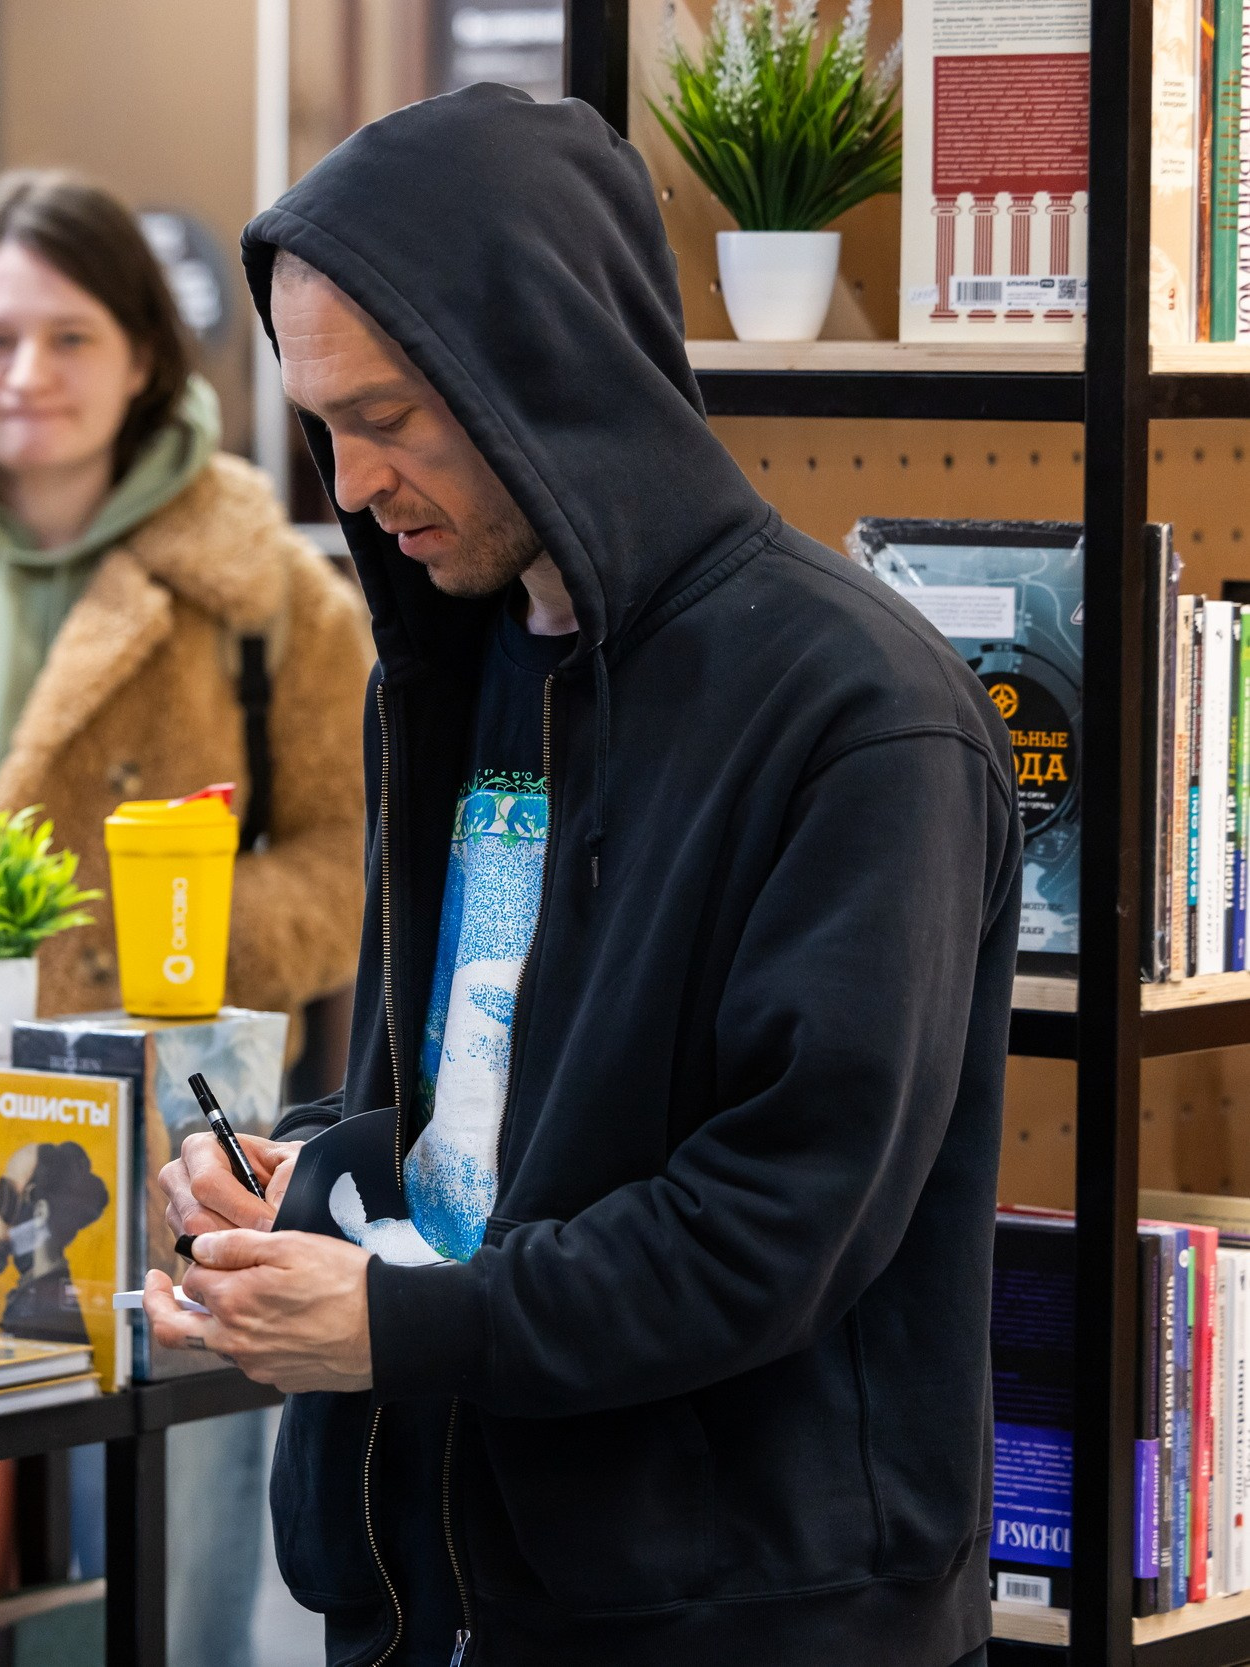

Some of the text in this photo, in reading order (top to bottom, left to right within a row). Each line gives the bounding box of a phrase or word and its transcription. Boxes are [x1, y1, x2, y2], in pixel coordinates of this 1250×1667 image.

[1218, 70, 1240, 231] ПРИБЫЛЬ
[1225, 794, 1236, 833] ИГР
[1224, 841, 1234, 909] ТЕОРИЯ
